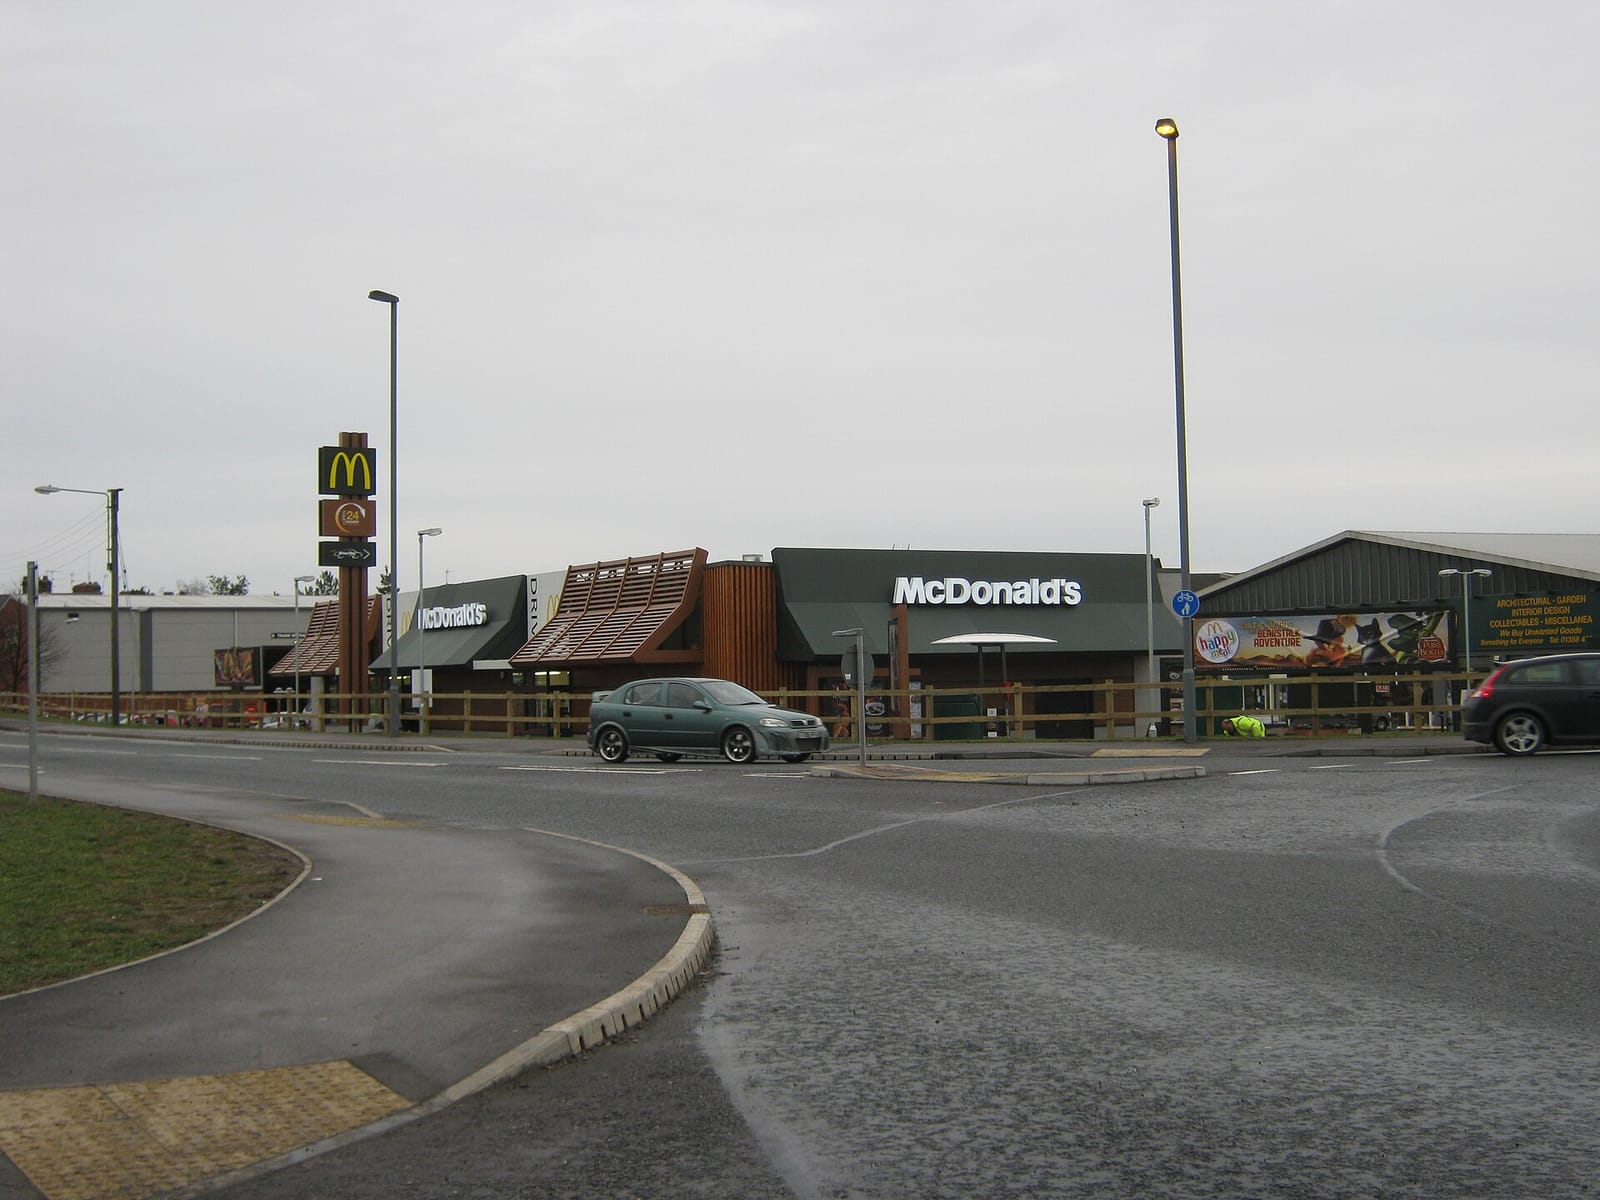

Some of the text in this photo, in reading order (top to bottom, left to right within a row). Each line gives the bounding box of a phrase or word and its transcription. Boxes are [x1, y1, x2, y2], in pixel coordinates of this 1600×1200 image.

[346, 511, 359, 520] 24
[893, 577, 1081, 606] McDonald's
[1497, 597, 1552, 608] ARCHITECTURAL
[1557, 595, 1586, 604] GARDEN
[418, 602, 487, 630] McDonald's
[1511, 606, 1570, 617] INTERIOR DESIGN
[1489, 617, 1539, 628] COLLECTABLES
[1544, 615, 1593, 625] MISCELLANEA
[1257, 629, 1301, 638] BEANSTALK
[1511, 629, 1524, 638] Buy
[1525, 628, 1559, 636] Unwanted
[1560, 626, 1582, 635] Goods
[1199, 630, 1236, 651] happy
[1253, 638, 1301, 648] ADVENTURE
